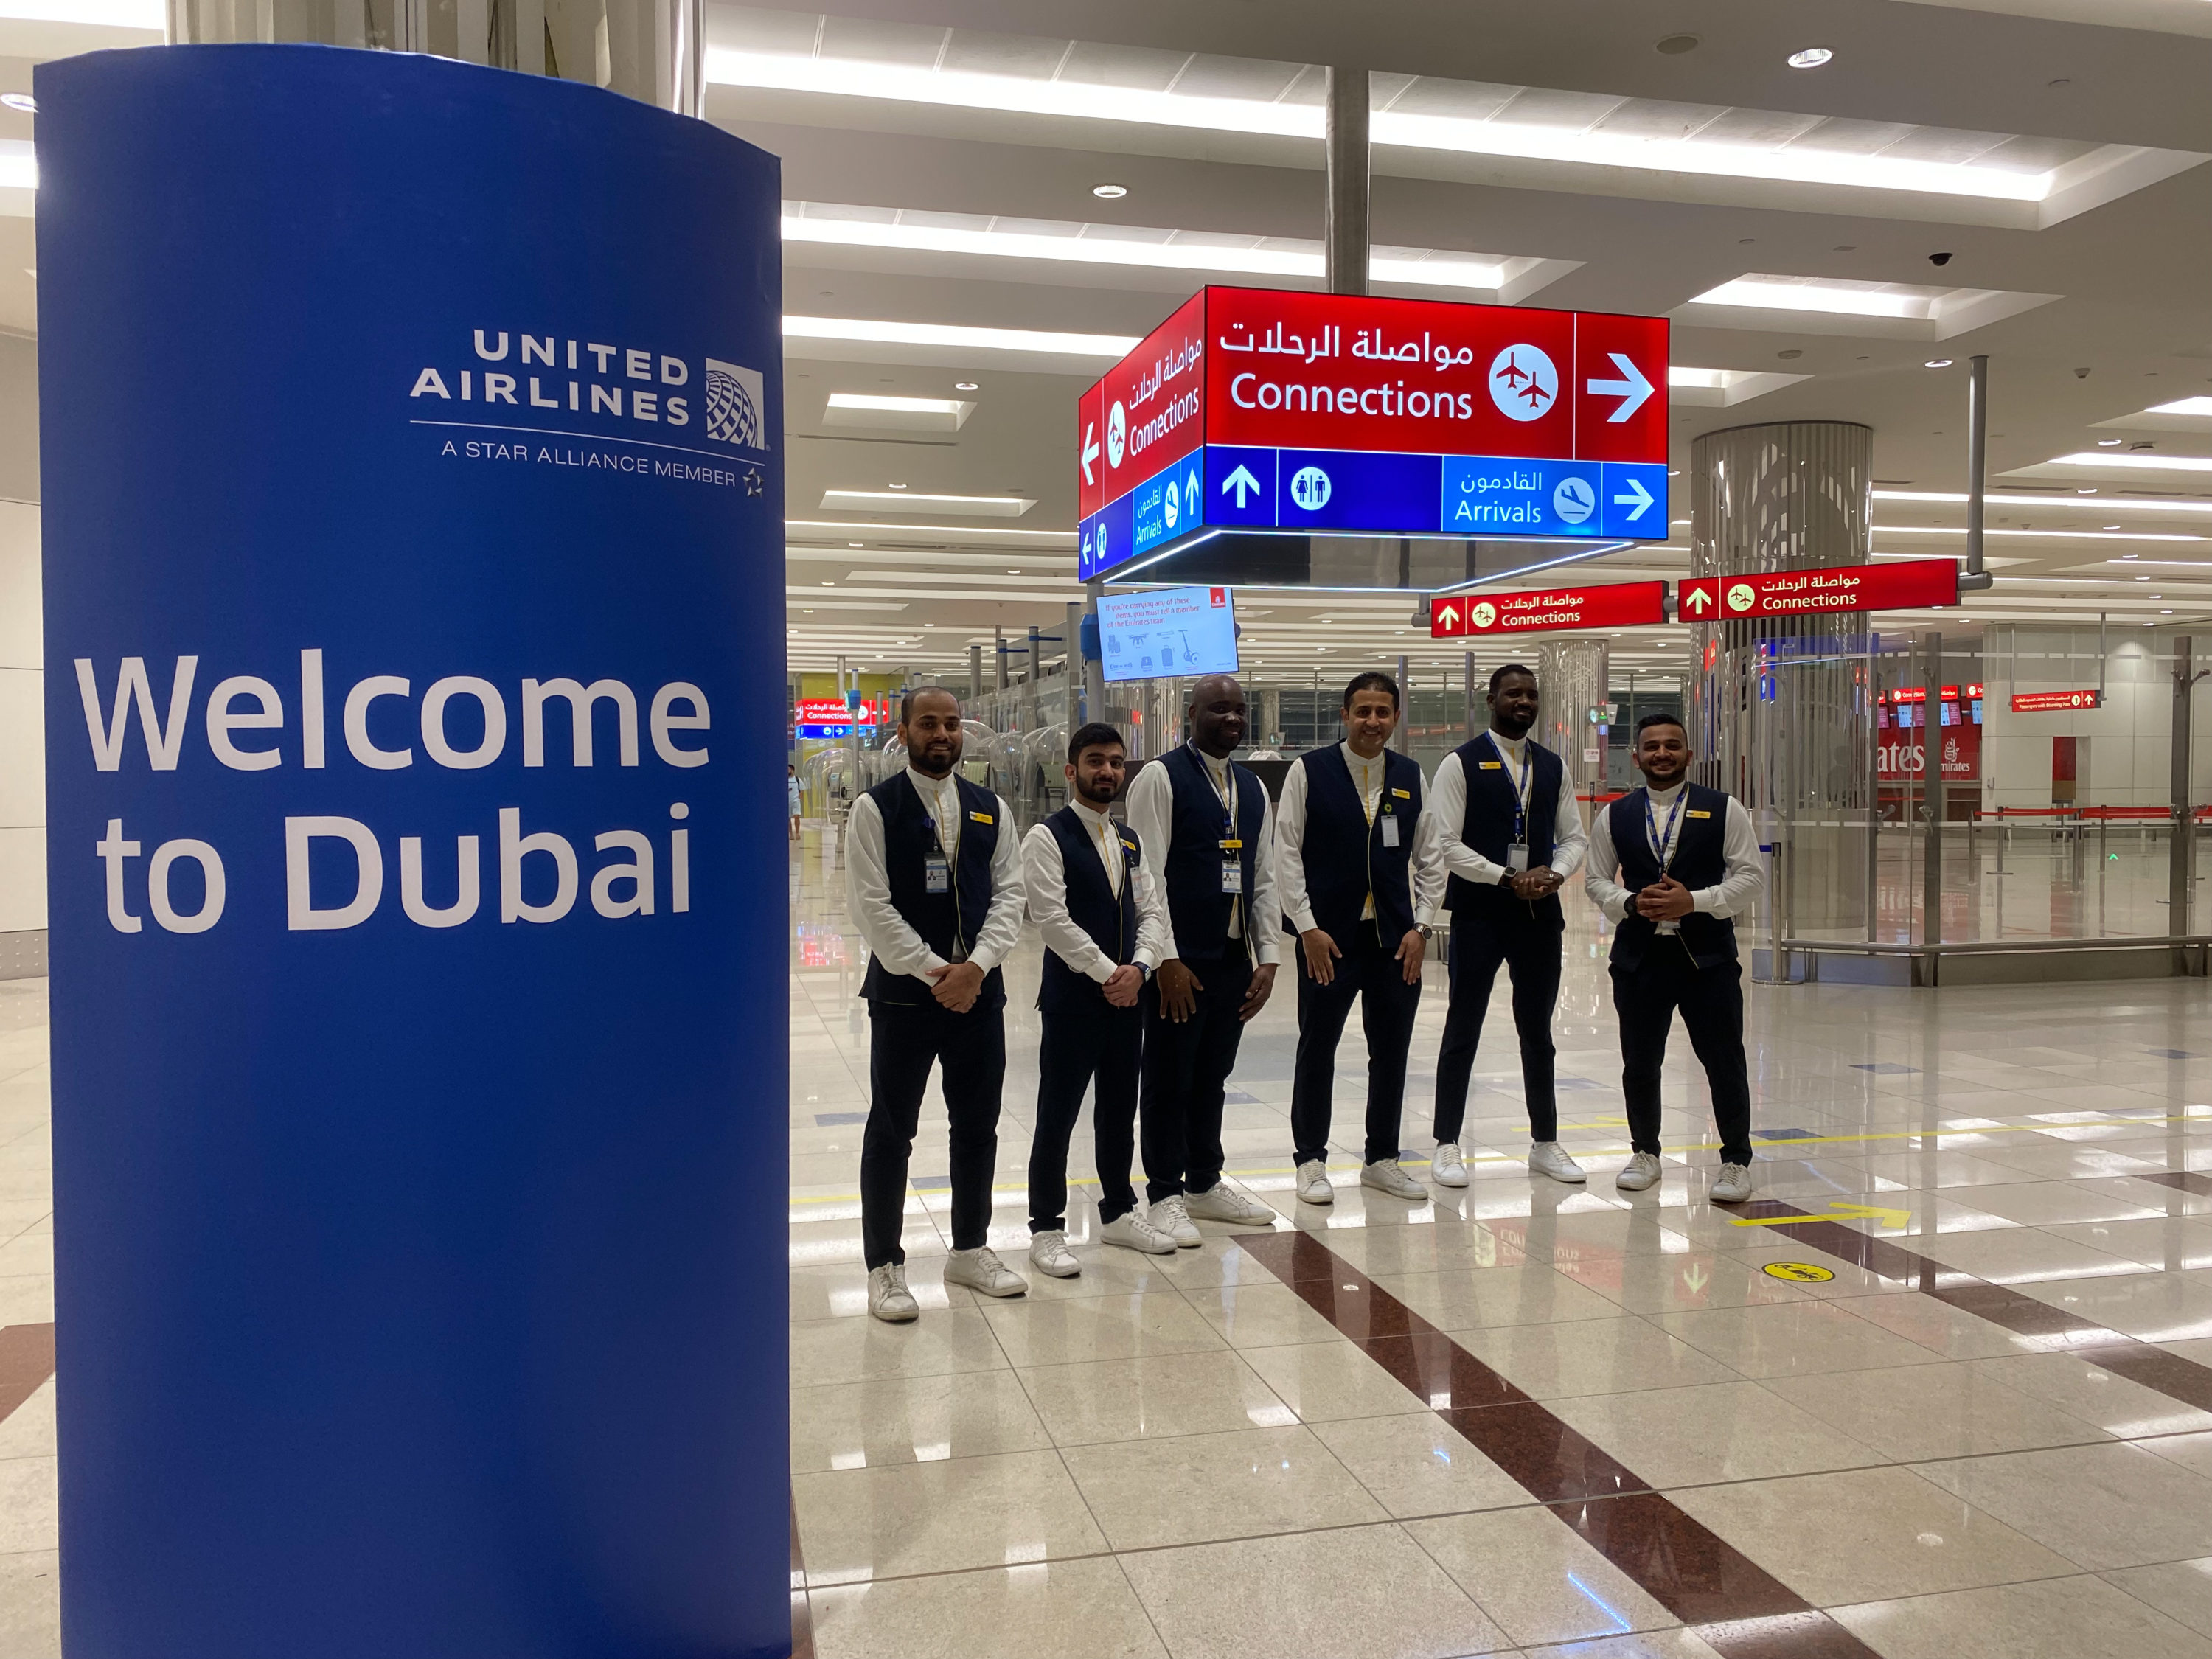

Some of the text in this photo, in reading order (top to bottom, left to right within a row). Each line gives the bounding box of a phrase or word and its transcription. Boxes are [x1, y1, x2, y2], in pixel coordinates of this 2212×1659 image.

[473, 329, 689, 386] UNITED
[1220, 322, 1472, 371] مواصلة الرحلات
[1129, 336, 1202, 410] مواصلة الرحلات
[409, 367, 689, 426] AIRLINES
[1231, 373, 1472, 419] Connections
[1130, 386, 1199, 457] Connections
[442, 440, 735, 487] A STAR ALLIANCE MEMBER
[1461, 472, 1541, 493] القادمون
[1138, 484, 1162, 519] القادمون
[1455, 501, 1540, 522] Arrivals
[1136, 517, 1162, 546] Arrivals
[1762, 574, 1860, 591] مواصلة الرحلات
[1130, 600, 1154, 610] carrying
[1155, 599, 1166, 608] any
[1175, 605, 1200, 613] member
[1501, 594, 1583, 610] مواصلة الرحلات
[1763, 593, 1856, 609] Connections
[1125, 618, 1150, 626] Emirates
[1502, 611, 1580, 626] Connections
[74, 649, 710, 771] Welcome
[1877, 741, 1925, 773] ates
[1941, 762, 1970, 771] mirates
[97, 803, 689, 933] to Dubai
